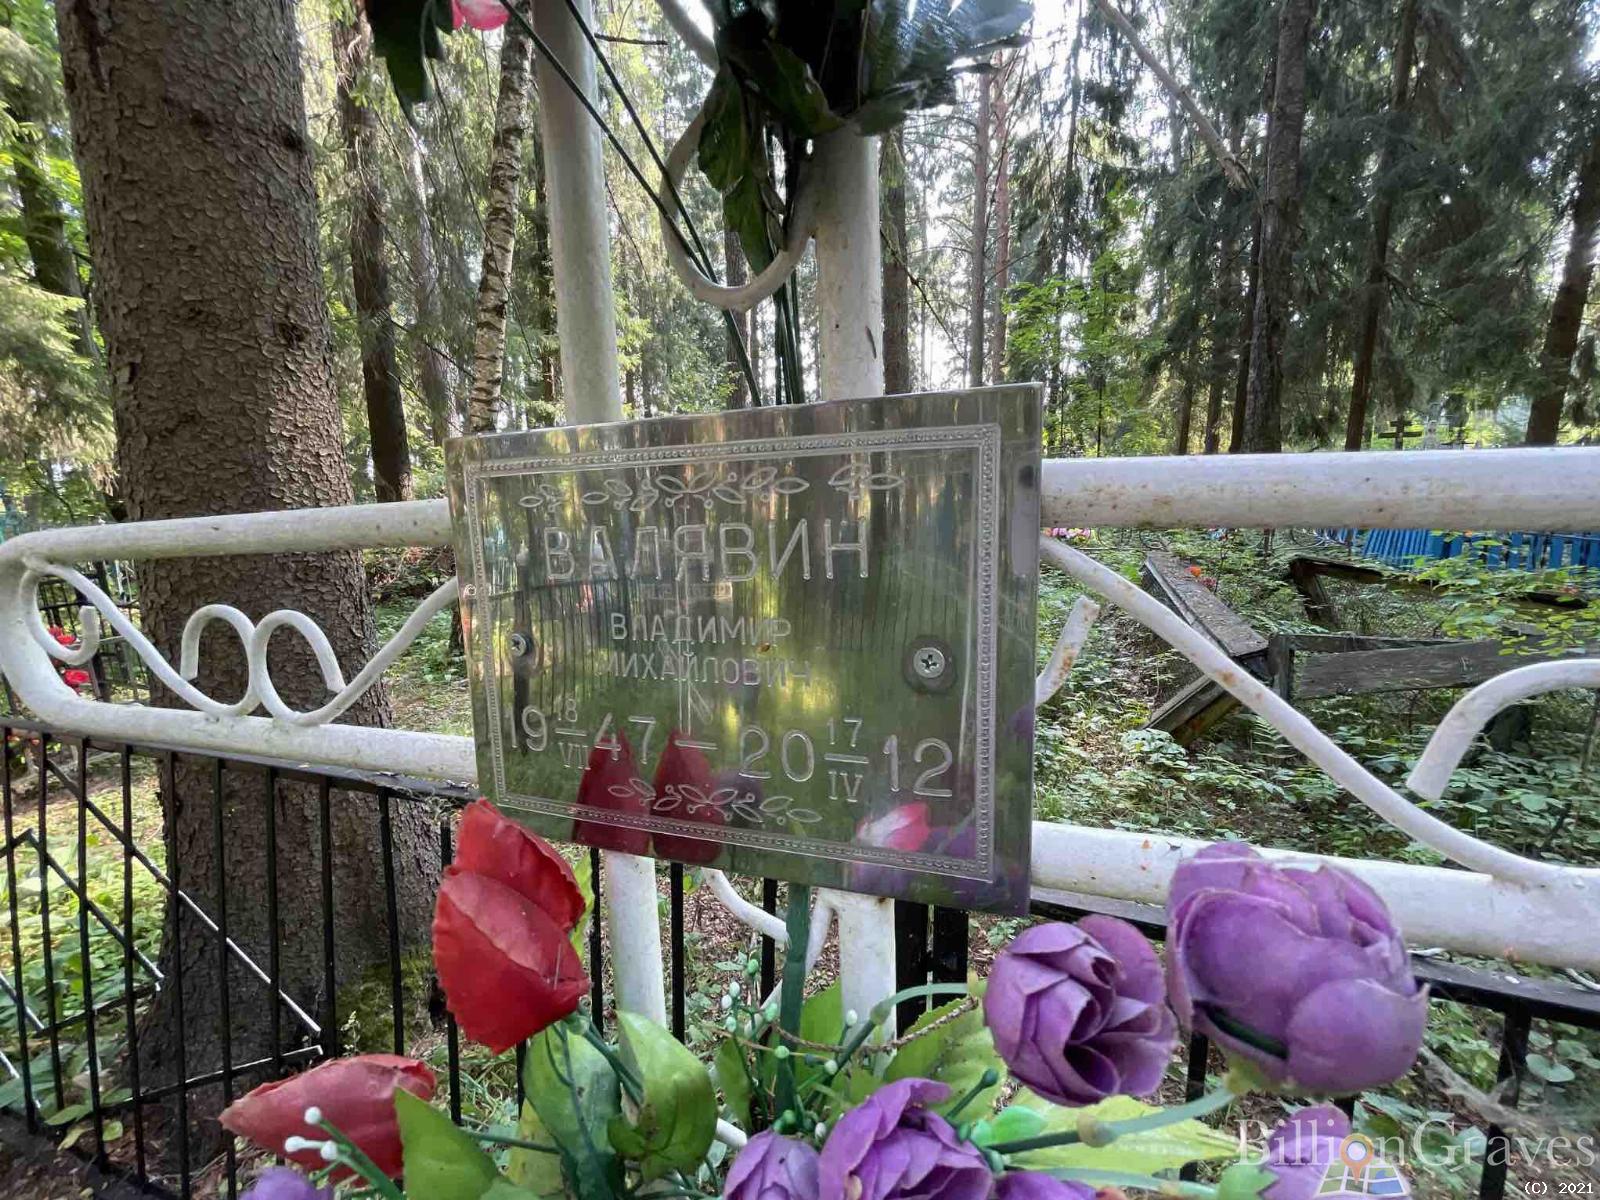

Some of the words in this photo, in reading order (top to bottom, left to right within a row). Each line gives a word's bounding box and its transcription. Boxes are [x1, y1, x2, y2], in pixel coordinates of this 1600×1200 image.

[543, 517, 870, 582] ВАЛЯВИН
[610, 612, 792, 648] ВЛАДИМИР
[594, 712, 657, 764] 47
[739, 724, 814, 782] 20
[883, 734, 953, 797] 12
[827, 717, 863, 747] 17
